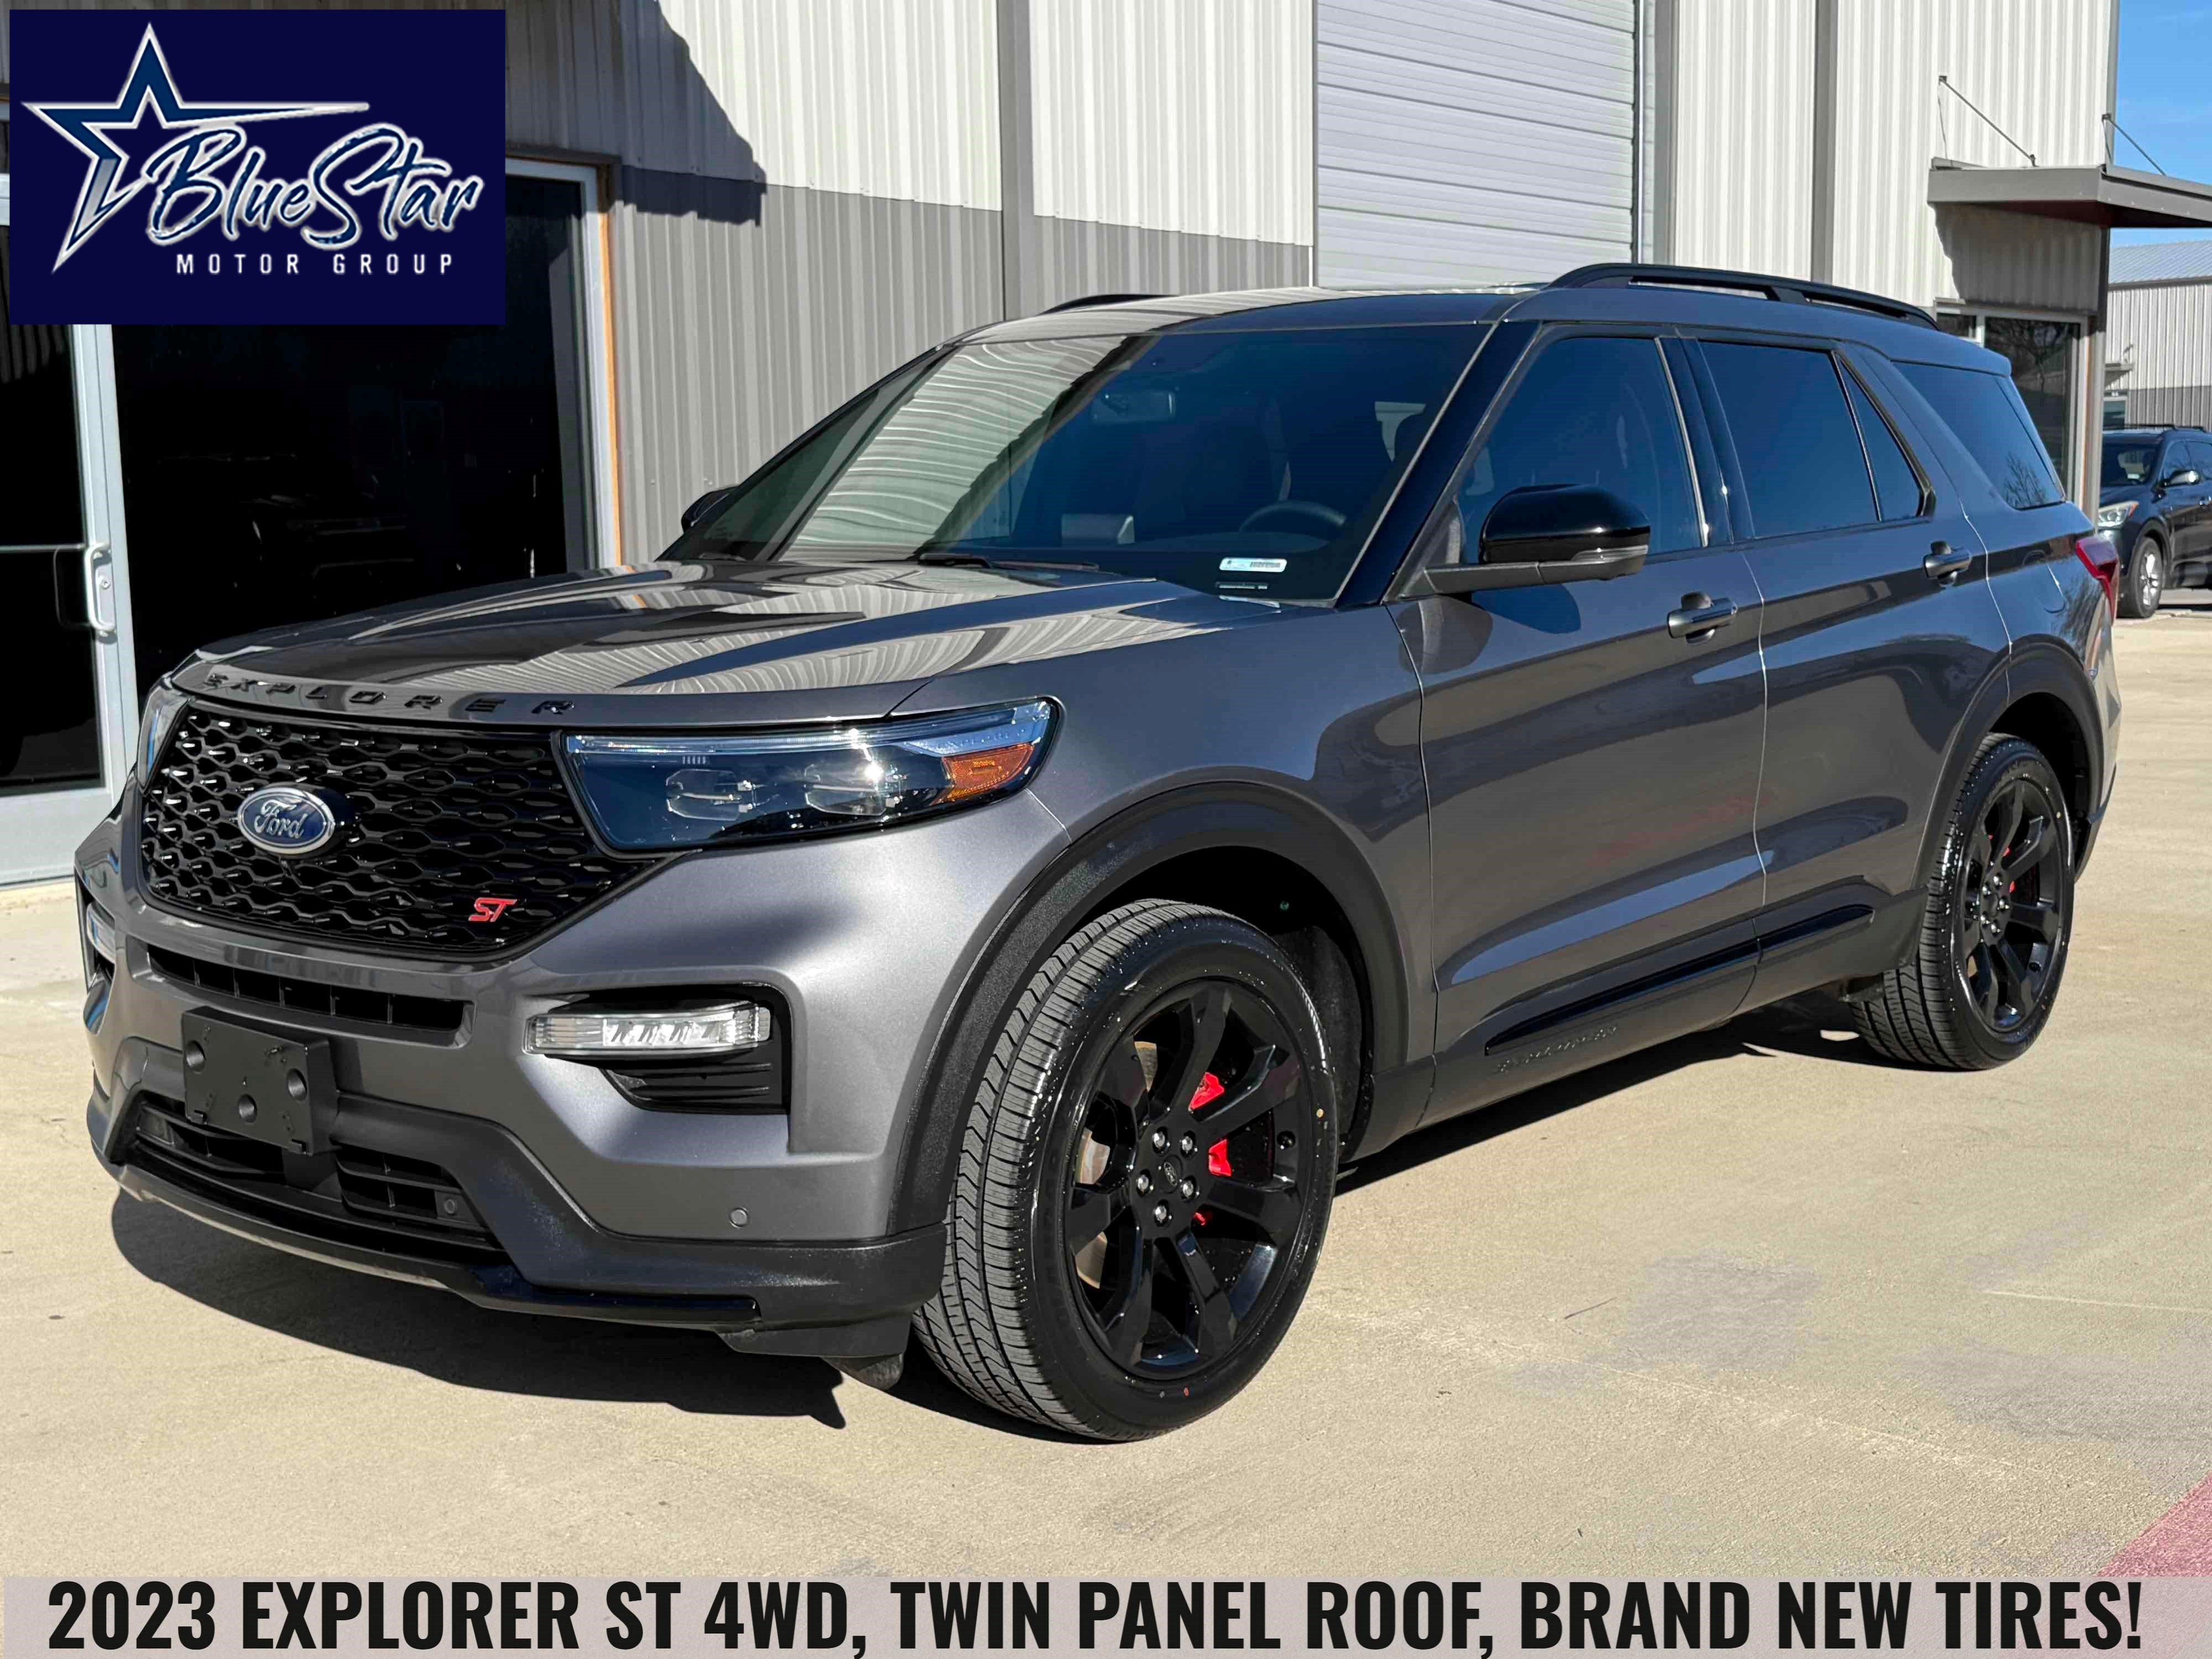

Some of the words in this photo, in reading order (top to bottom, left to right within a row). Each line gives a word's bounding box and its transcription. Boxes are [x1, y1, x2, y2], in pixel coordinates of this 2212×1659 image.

[203, 673, 575, 714] EXPLORER
[254, 799, 308, 839] Ford
[469, 896, 517, 922] ST
